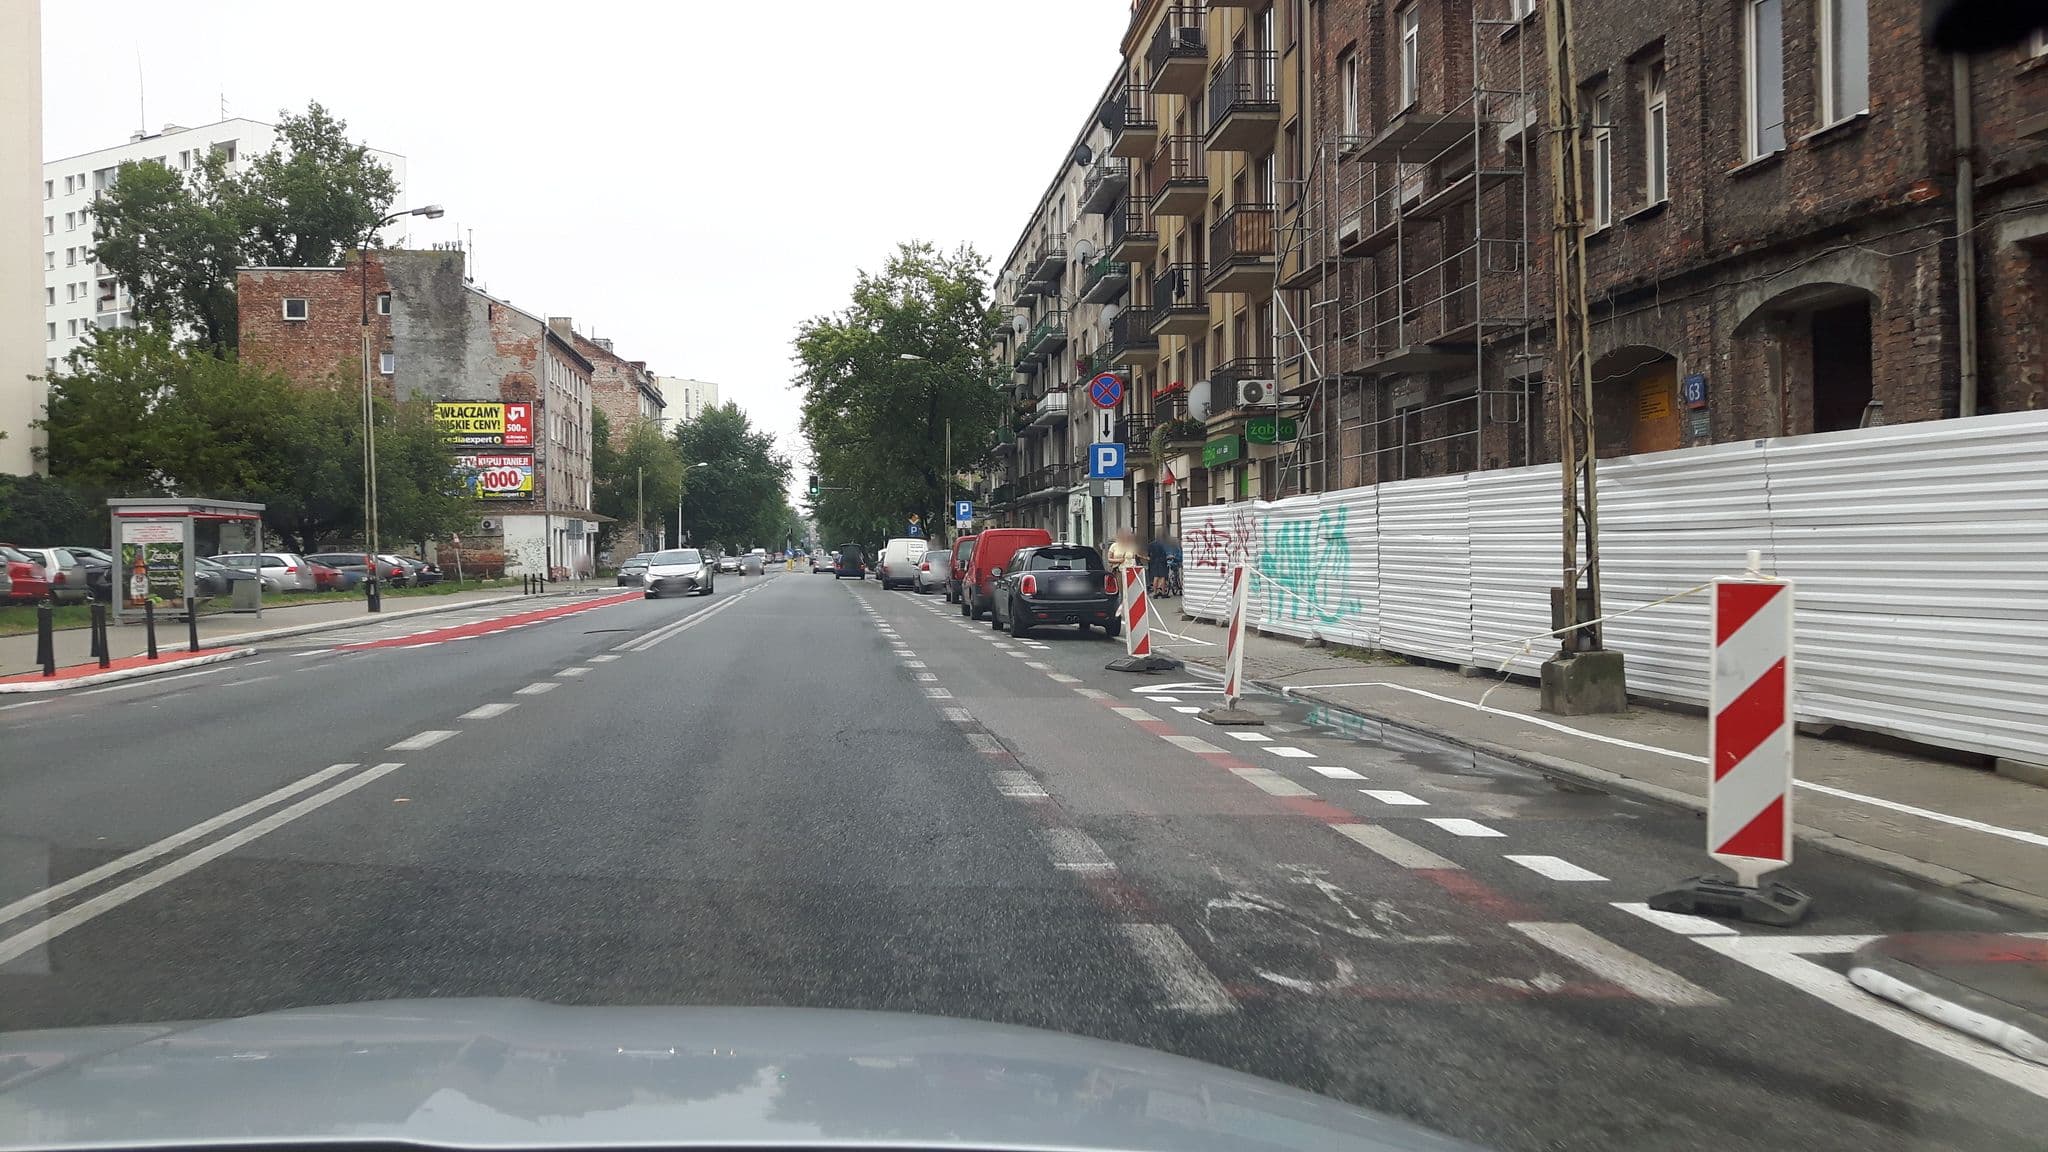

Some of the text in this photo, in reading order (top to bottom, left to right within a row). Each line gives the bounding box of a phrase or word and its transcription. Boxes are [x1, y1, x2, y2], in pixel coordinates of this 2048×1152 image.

[1689, 383, 1700, 401] 63
[440, 407, 500, 419] WŁĄCZAMY
[473, 420, 501, 430] CENY!
[507, 423, 521, 432] 500
[478, 457, 501, 466] KUPUJ
[1097, 447, 1118, 474] P
[960, 503, 969, 515] P
